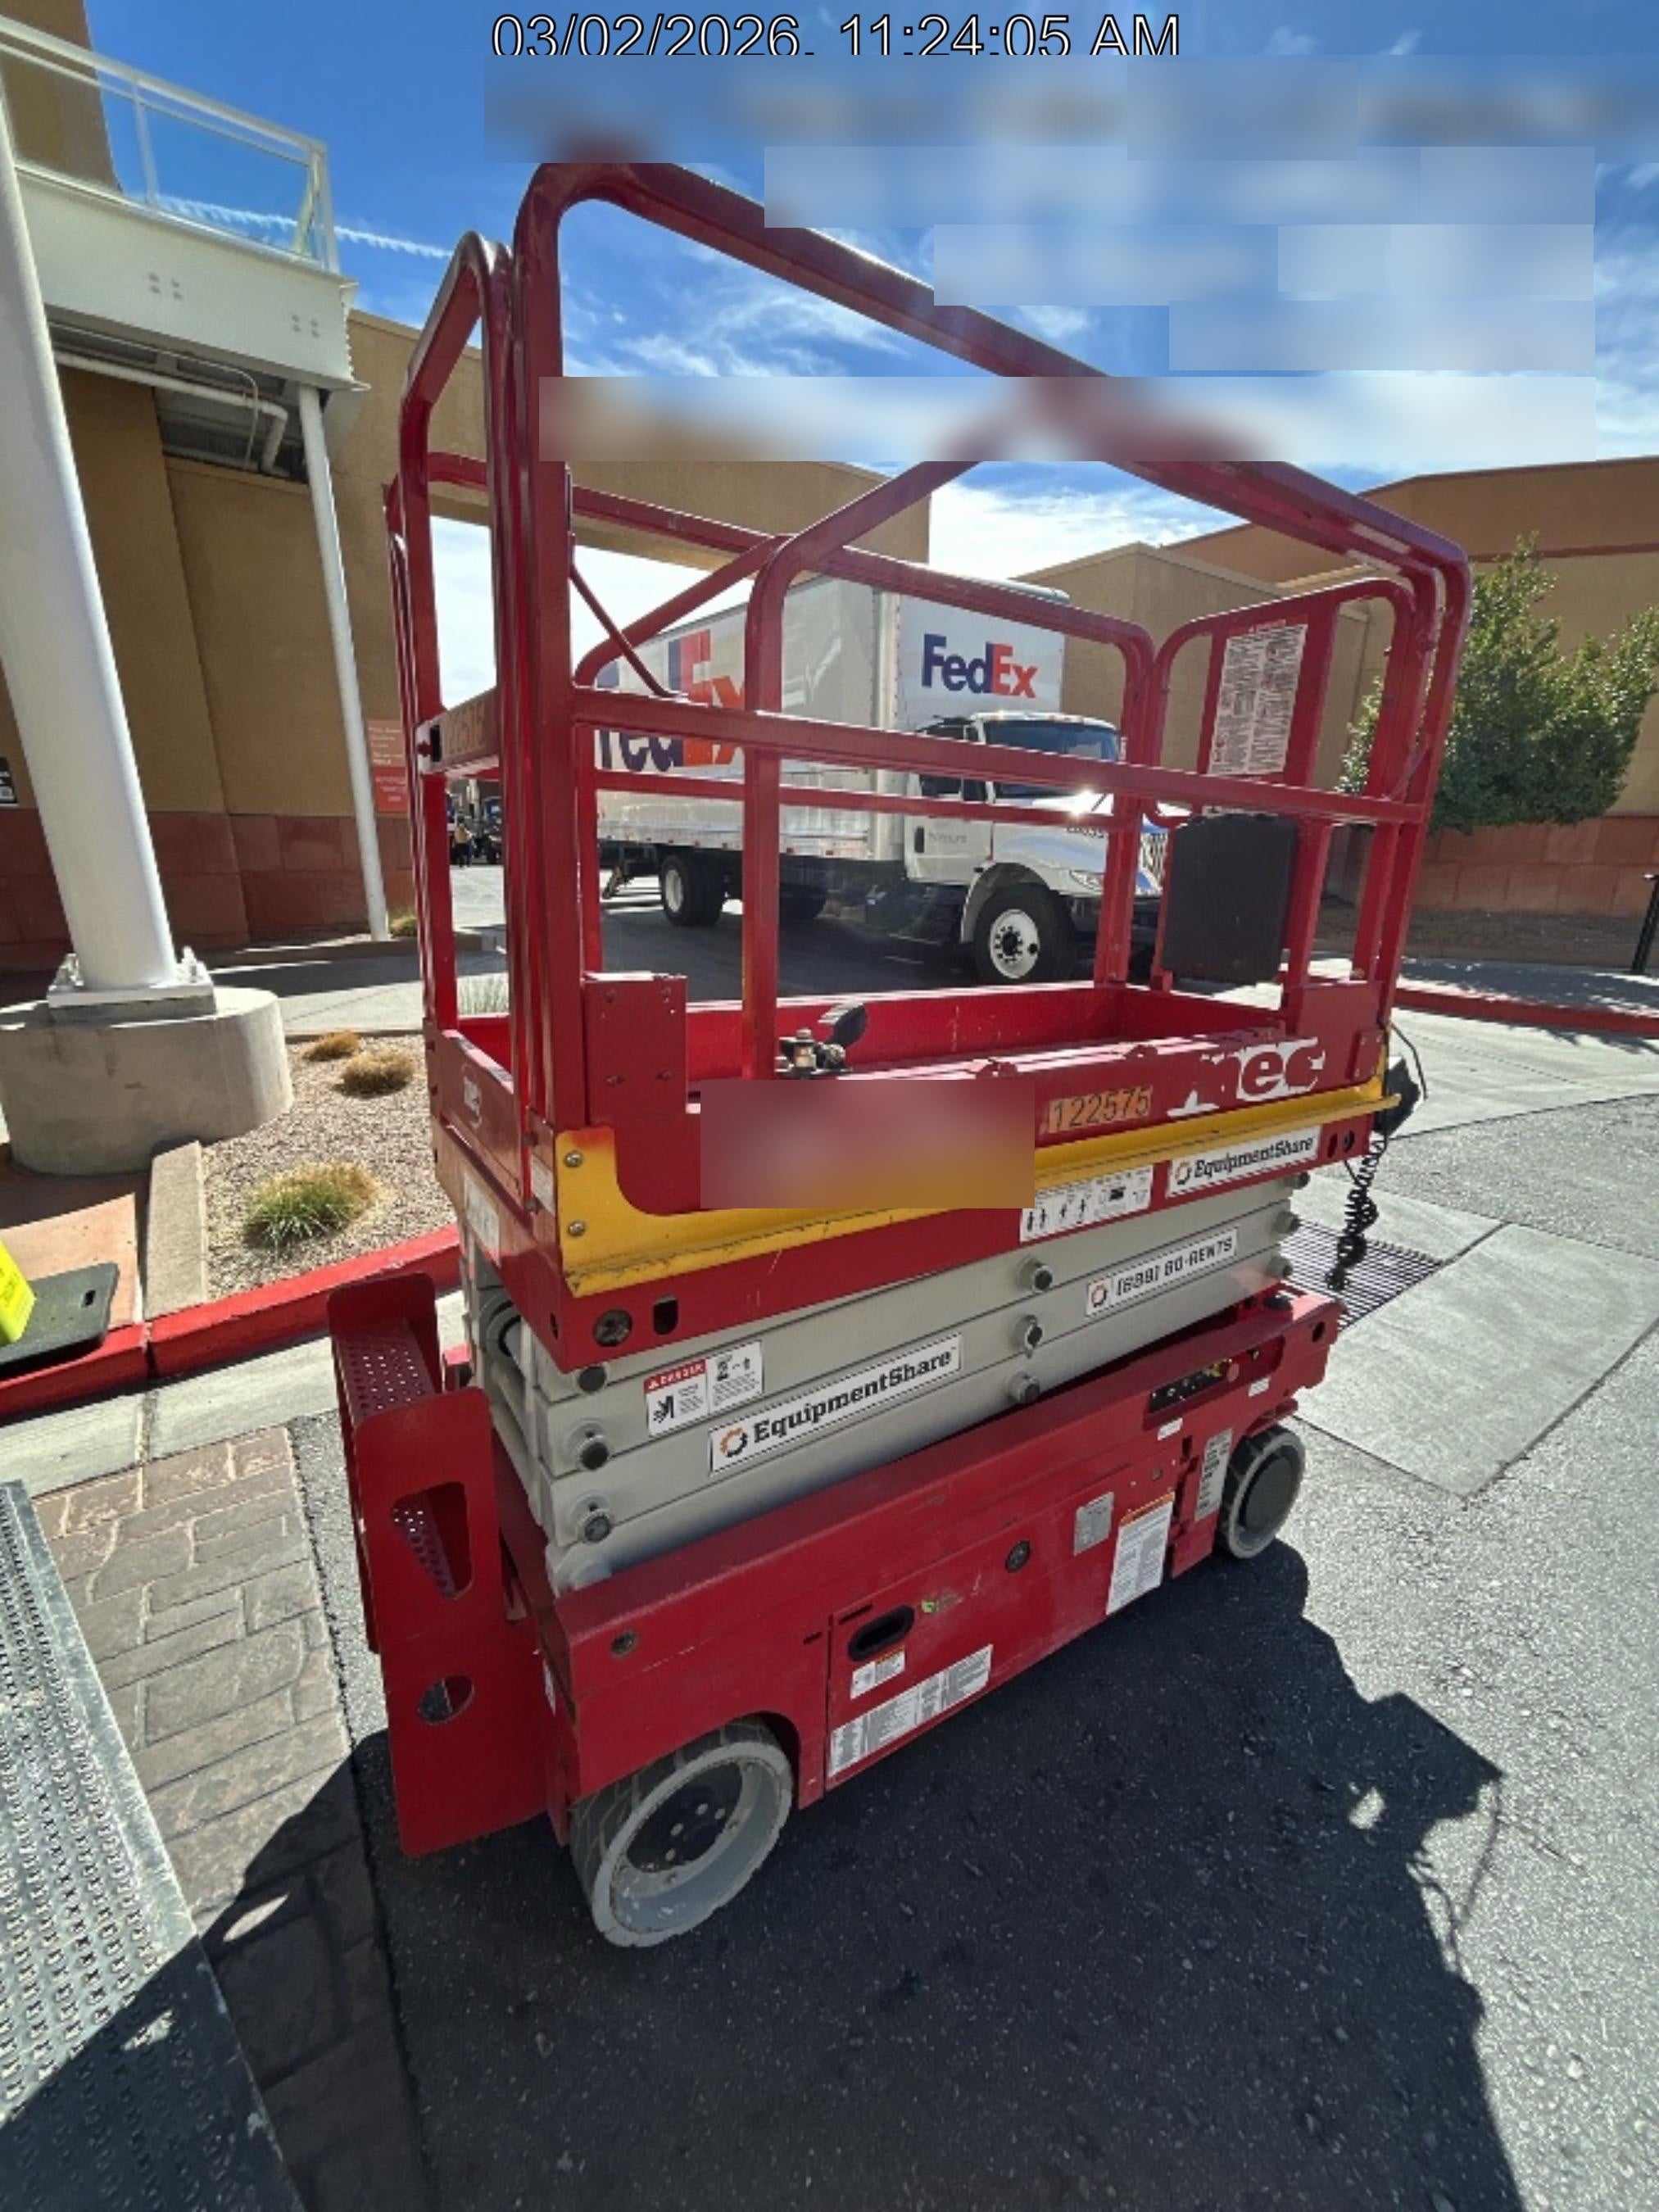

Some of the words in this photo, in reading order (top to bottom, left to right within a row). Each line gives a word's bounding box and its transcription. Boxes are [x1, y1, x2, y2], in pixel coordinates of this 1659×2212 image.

[922, 633, 1038, 699] FedEx
[1054, 1085, 1149, 1127] 122575
[1194, 1137, 1315, 1180] EquipmentShare
[753, 1350, 952, 1444] EquipmentShare
